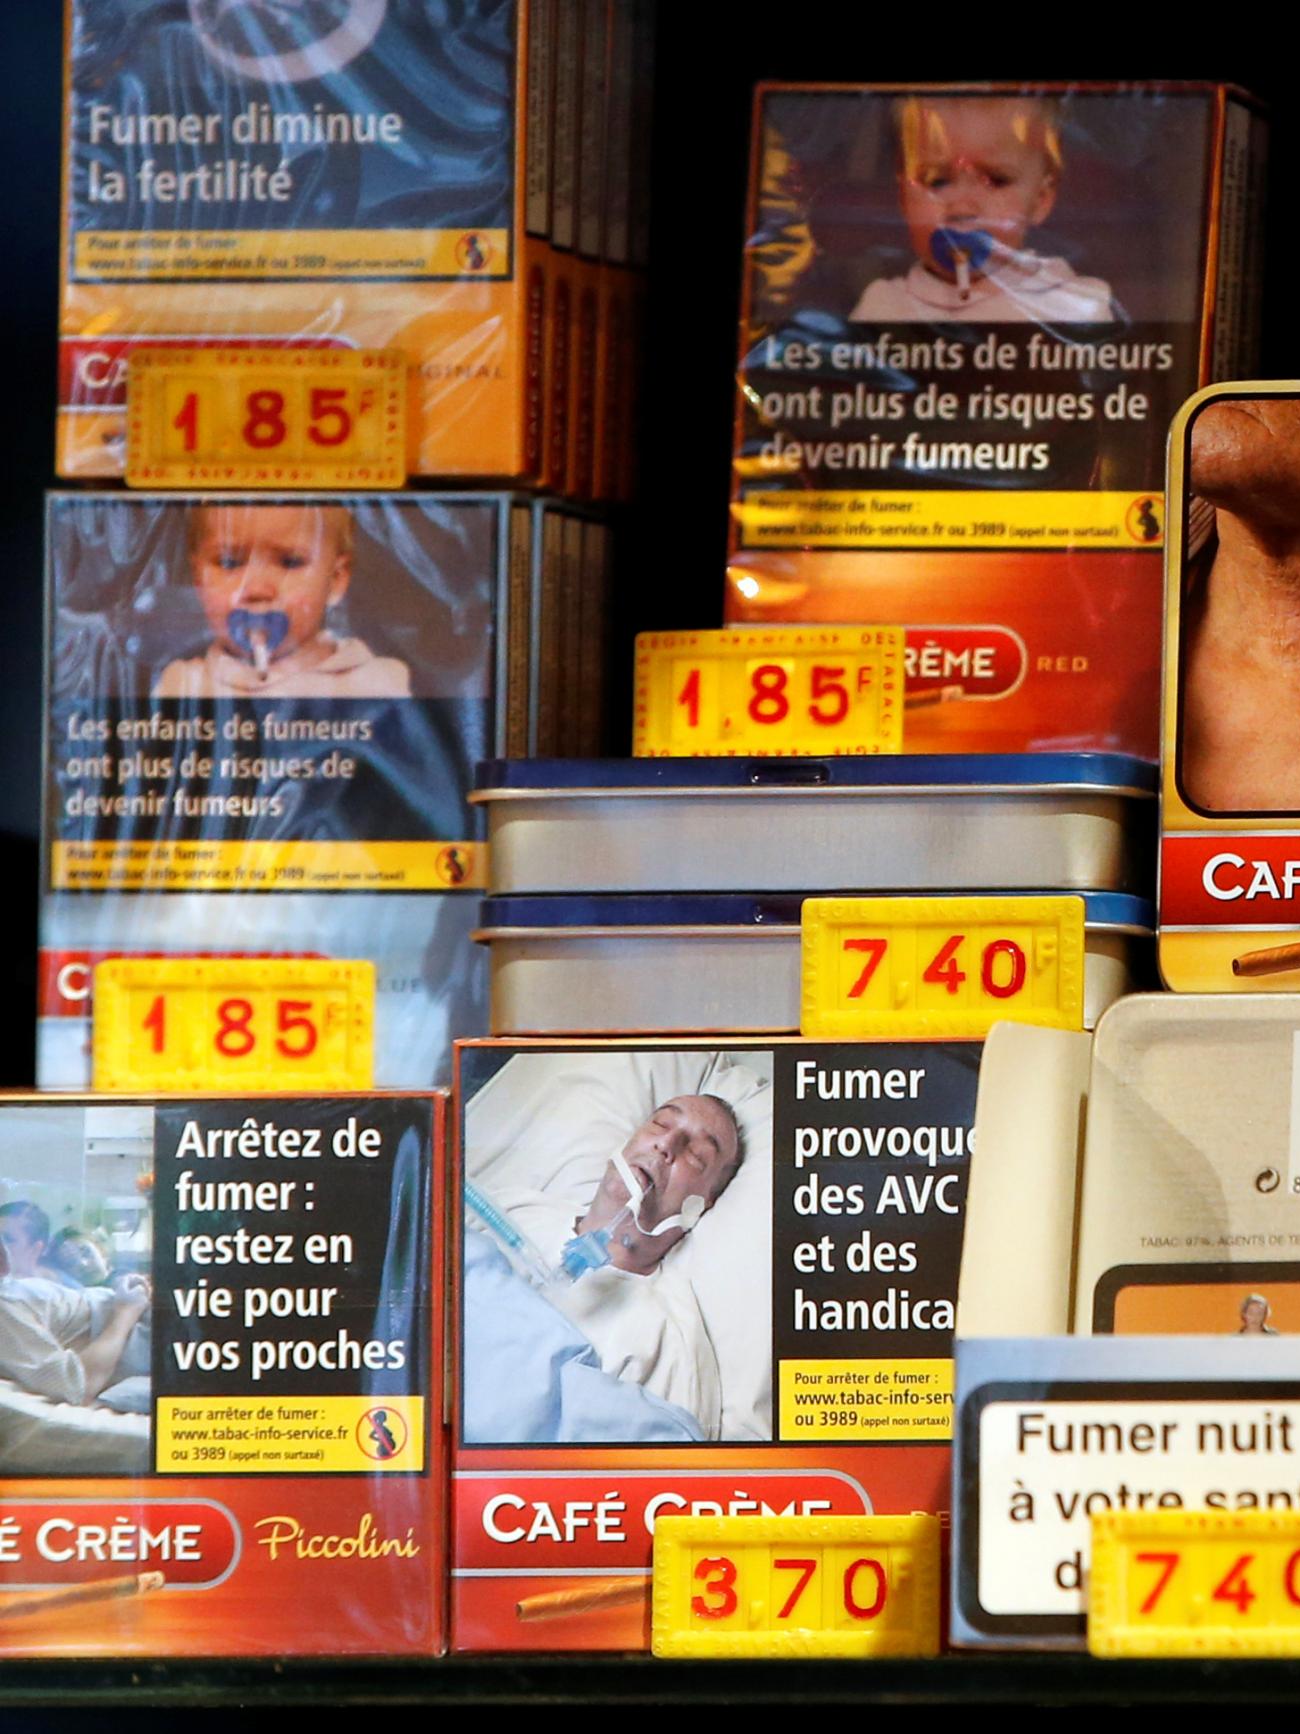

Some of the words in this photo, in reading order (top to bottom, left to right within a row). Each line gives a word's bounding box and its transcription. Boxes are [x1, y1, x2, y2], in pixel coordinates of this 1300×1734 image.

[90, 103, 220, 145] Fumer
[233, 102, 403, 145] diminue
[90, 160, 124, 203] la
[138, 157, 293, 203] fertilité
[766, 335, 822, 370] Les
[832, 332, 964, 370] enfants
[974, 333, 1017, 370] de
[1027, 333, 1172, 370] fumeurs
[763, 388, 822, 421] ont
[830, 383, 904, 427] plus
[913, 384, 958, 421] de
[968, 384, 1094, 427] risques
[1104, 384, 1148, 420] de
[761, 435, 894, 469] devenir
[903, 433, 1048, 469] fumeurs
[1036, 656, 1088, 674] RED
[67, 714, 110, 741] Les
[117, 711, 215, 741] enfants
[223, 712, 255, 741] de
[263, 711, 372, 741] fumeurs
[66, 754, 112, 778] ont
[118, 751, 174, 784] plus
[181, 751, 212, 778] de
[220, 750, 314, 785] risques
[322, 750, 355, 778] de
[66, 789, 167, 818] devenir
[174, 789, 284, 818] fumeurs
[796, 1061, 925, 1099] Fumer
[175, 1118, 321, 1158] Arrêtez
[332, 1118, 381, 1158] de
[175, 1172, 295, 1211] fumer
[793, 1174, 863, 1215] des
[876, 1175, 959, 1214] AVC
[175, 1229, 293, 1265] restez
[305, 1234, 351, 1264] en
[793, 1236, 834, 1272] et
[846, 1231, 916, 1272] des
[174, 1280, 231, 1317] vie
[245, 1287, 337, 1328] pour
[794, 1289, 954, 1331] handica
[174, 1340, 239, 1371] vos
[252, 1330, 405, 1380] proches
[795, 1372, 822, 1384] Pour
[827, 1372, 870, 1384] arrêter
[874, 1372, 889, 1384] de
[894, 1371, 929, 1384] fumer
[172, 1408, 202, 1421] Pour
[207, 1407, 253, 1420] arrêter
[257, 1407, 273, 1420] de
[277, 1407, 318, 1420] fumer
[172, 1425, 348, 1440] www.tabac-info-service.fr
[795, 1414, 814, 1426] ou
[819, 1411, 857, 1426] 3989
[860, 1416, 889, 1428] (appel
[912, 1416, 950, 1426] surtaxé)
[1017, 1413, 1178, 1454] Fumer
[1197, 1412, 1293, 1453] nuit
[171, 1450, 188, 1460] ou
[193, 1447, 225, 1460] 3989
[263, 1451, 281, 1459] non
[483, 1491, 626, 1544] CAFÉ
[1009, 1483, 1035, 1522] à
[1055, 1484, 1184, 1522] votre
[36, 1517, 203, 1561] CRÈME
[255, 1513, 419, 1560] Piccolini
